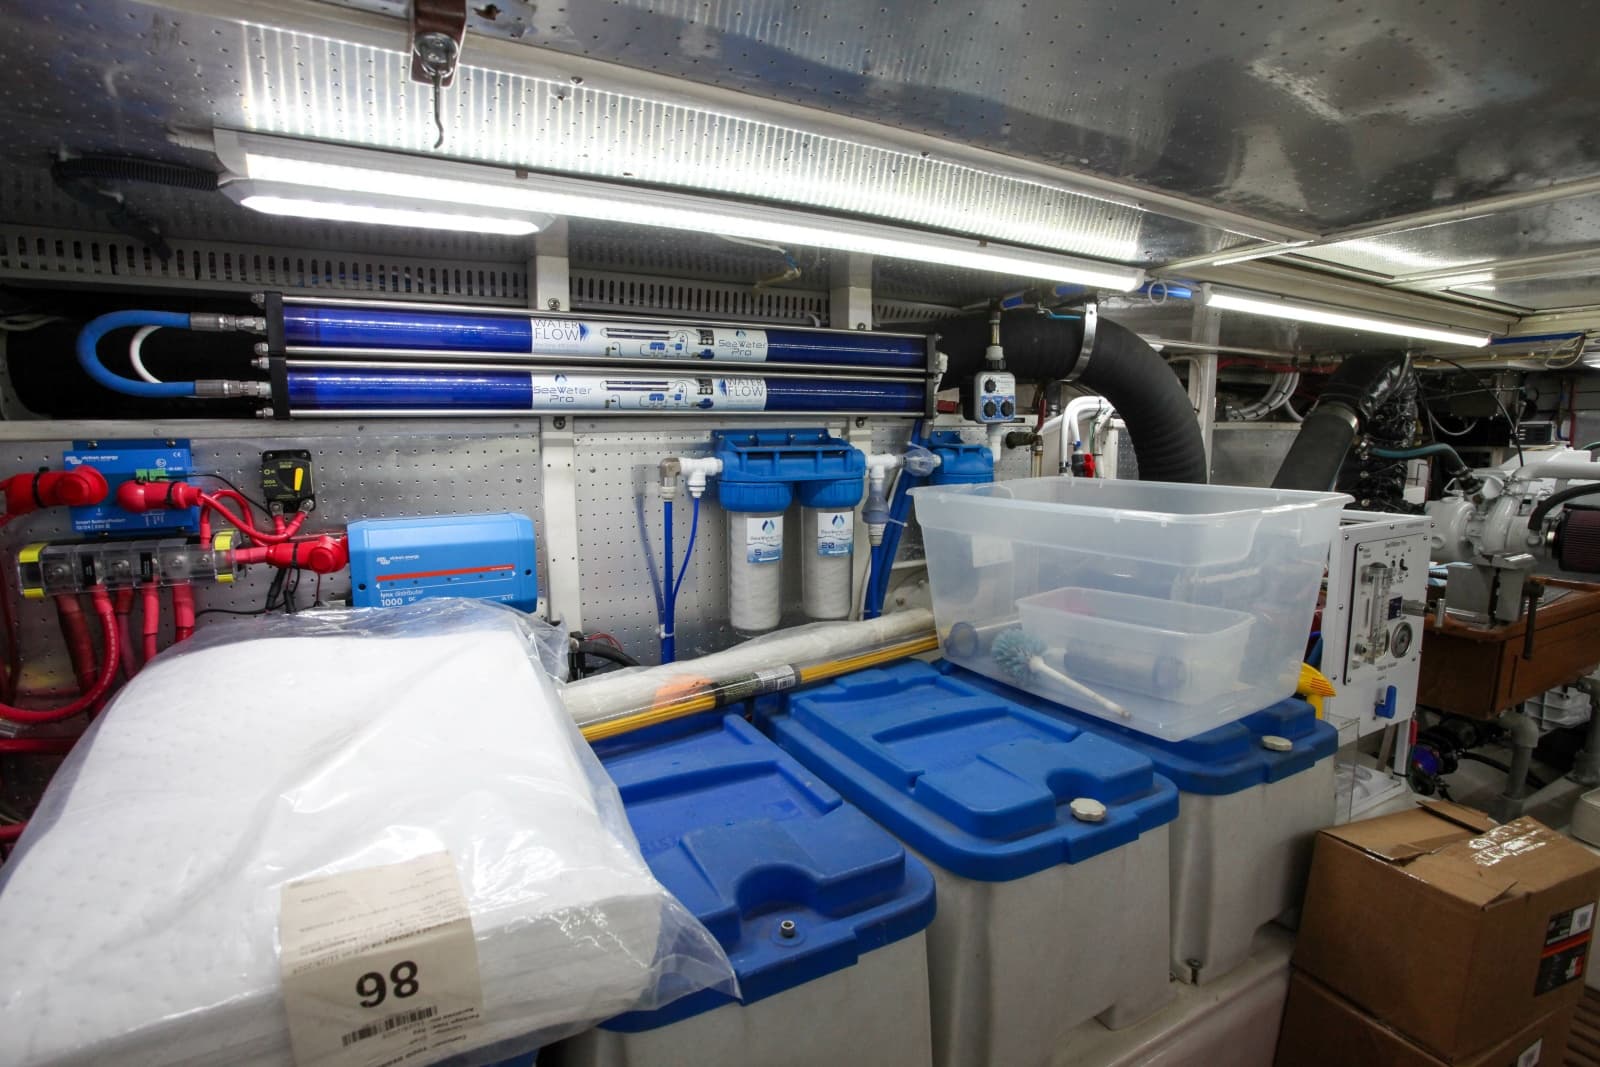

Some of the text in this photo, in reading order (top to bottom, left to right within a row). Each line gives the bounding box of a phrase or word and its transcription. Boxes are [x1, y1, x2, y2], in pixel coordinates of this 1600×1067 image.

[535, 319, 579, 329] WATER
[535, 327, 579, 341] FLOW
[731, 347, 752, 356] Pro
[728, 385, 764, 397] FLOW
[549, 394, 575, 403] Pro
[381, 598, 403, 607] 1000
